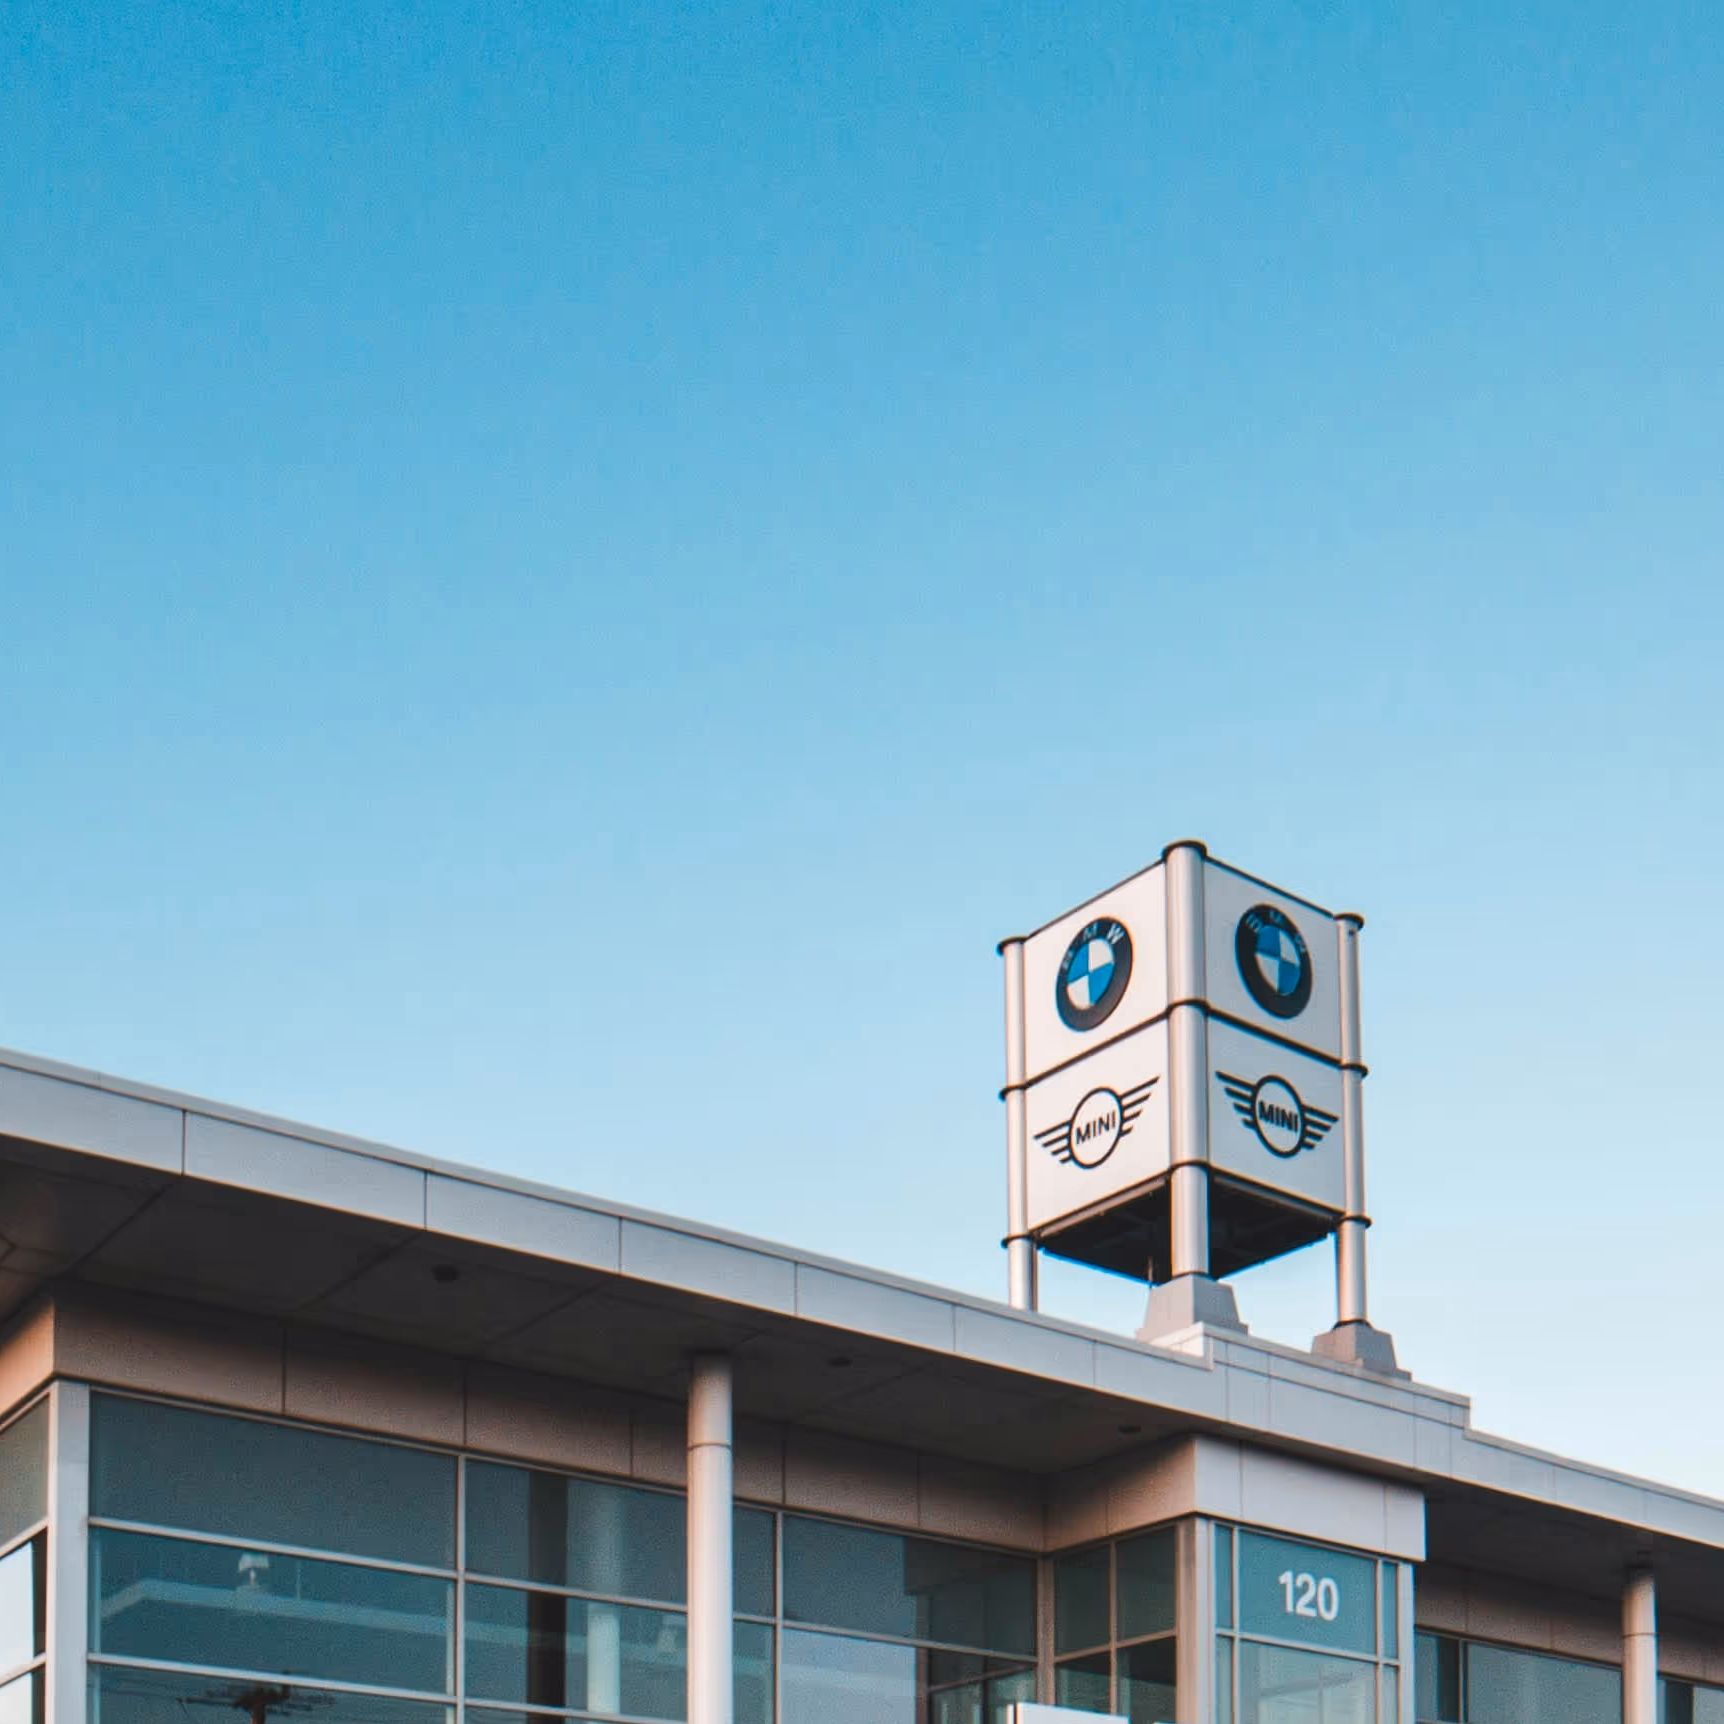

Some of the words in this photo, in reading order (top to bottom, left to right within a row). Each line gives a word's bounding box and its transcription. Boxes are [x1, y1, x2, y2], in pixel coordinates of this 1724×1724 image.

[1076, 1109, 1116, 1145] MINI
[1258, 1100, 1298, 1133] MINI
[1278, 1570, 1339, 1621] 120
